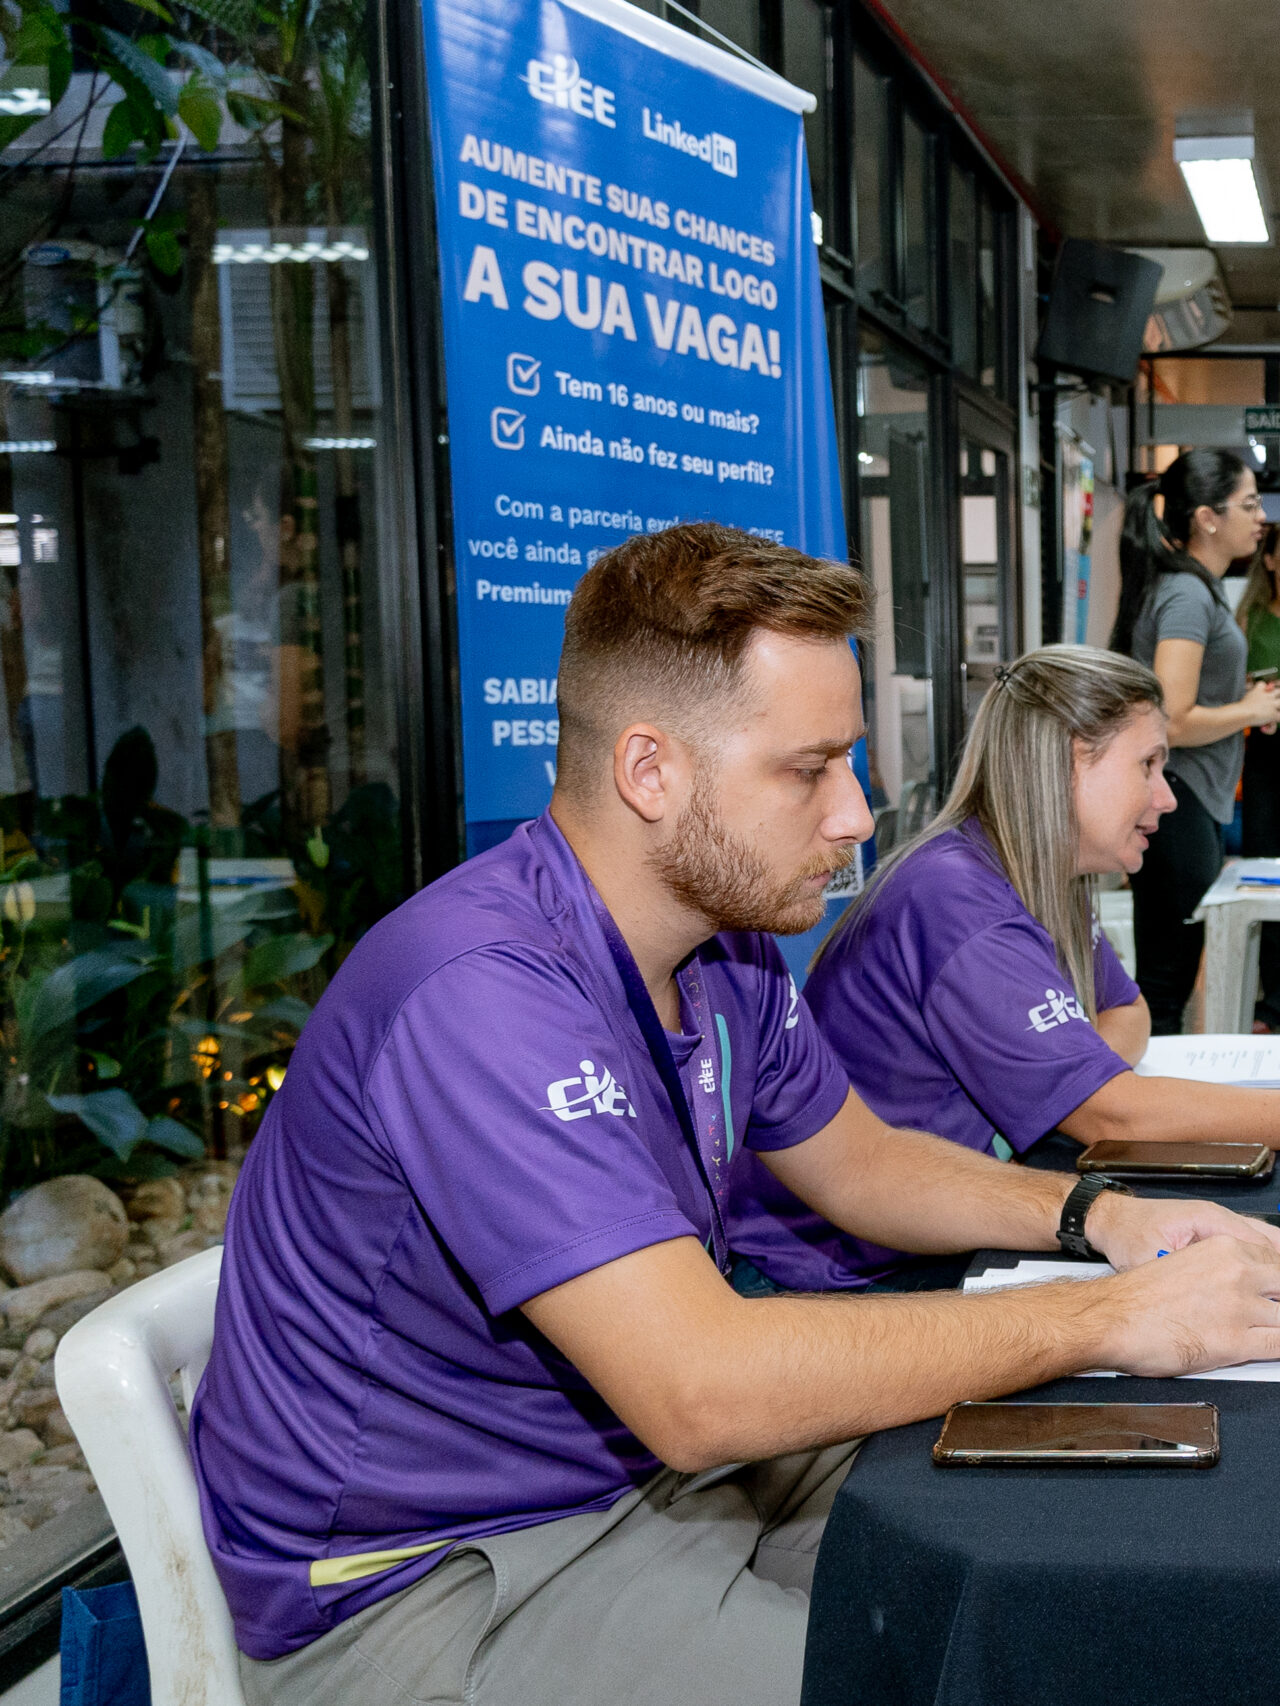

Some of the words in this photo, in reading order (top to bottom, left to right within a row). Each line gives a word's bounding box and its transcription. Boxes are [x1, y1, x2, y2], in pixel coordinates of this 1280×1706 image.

[459, 134, 603, 206] AUMENTE
[606, 184, 671, 230] SUAS
[674, 209, 776, 267] CHANCES
[459, 182, 509, 229] DE
[516, 200, 704, 289] ENCONTRAR
[709, 262, 778, 311] LOGO
[463, 245, 509, 310] A
[522, 261, 637, 342] SUA
[644, 293, 782, 379] VAGA!
[554, 371, 603, 402] Tem
[607, 383, 629, 407] 16
[633, 393, 678, 418] anos
[682, 404, 705, 424] ou
[709, 409, 760, 435] mais?
[540, 425, 605, 457] Ainda
[609, 437, 645, 463] não
[648, 443, 678, 469] fez
[681, 455, 714, 476] seu
[718, 461, 774, 486] perfil?
[495, 495, 544, 519] Com
[550, 505, 563, 523] a
[569, 507, 643, 532] parceria
[468, 536, 519, 560] você
[525, 541, 582, 565] ainda
[477, 579, 573, 606] Premium
